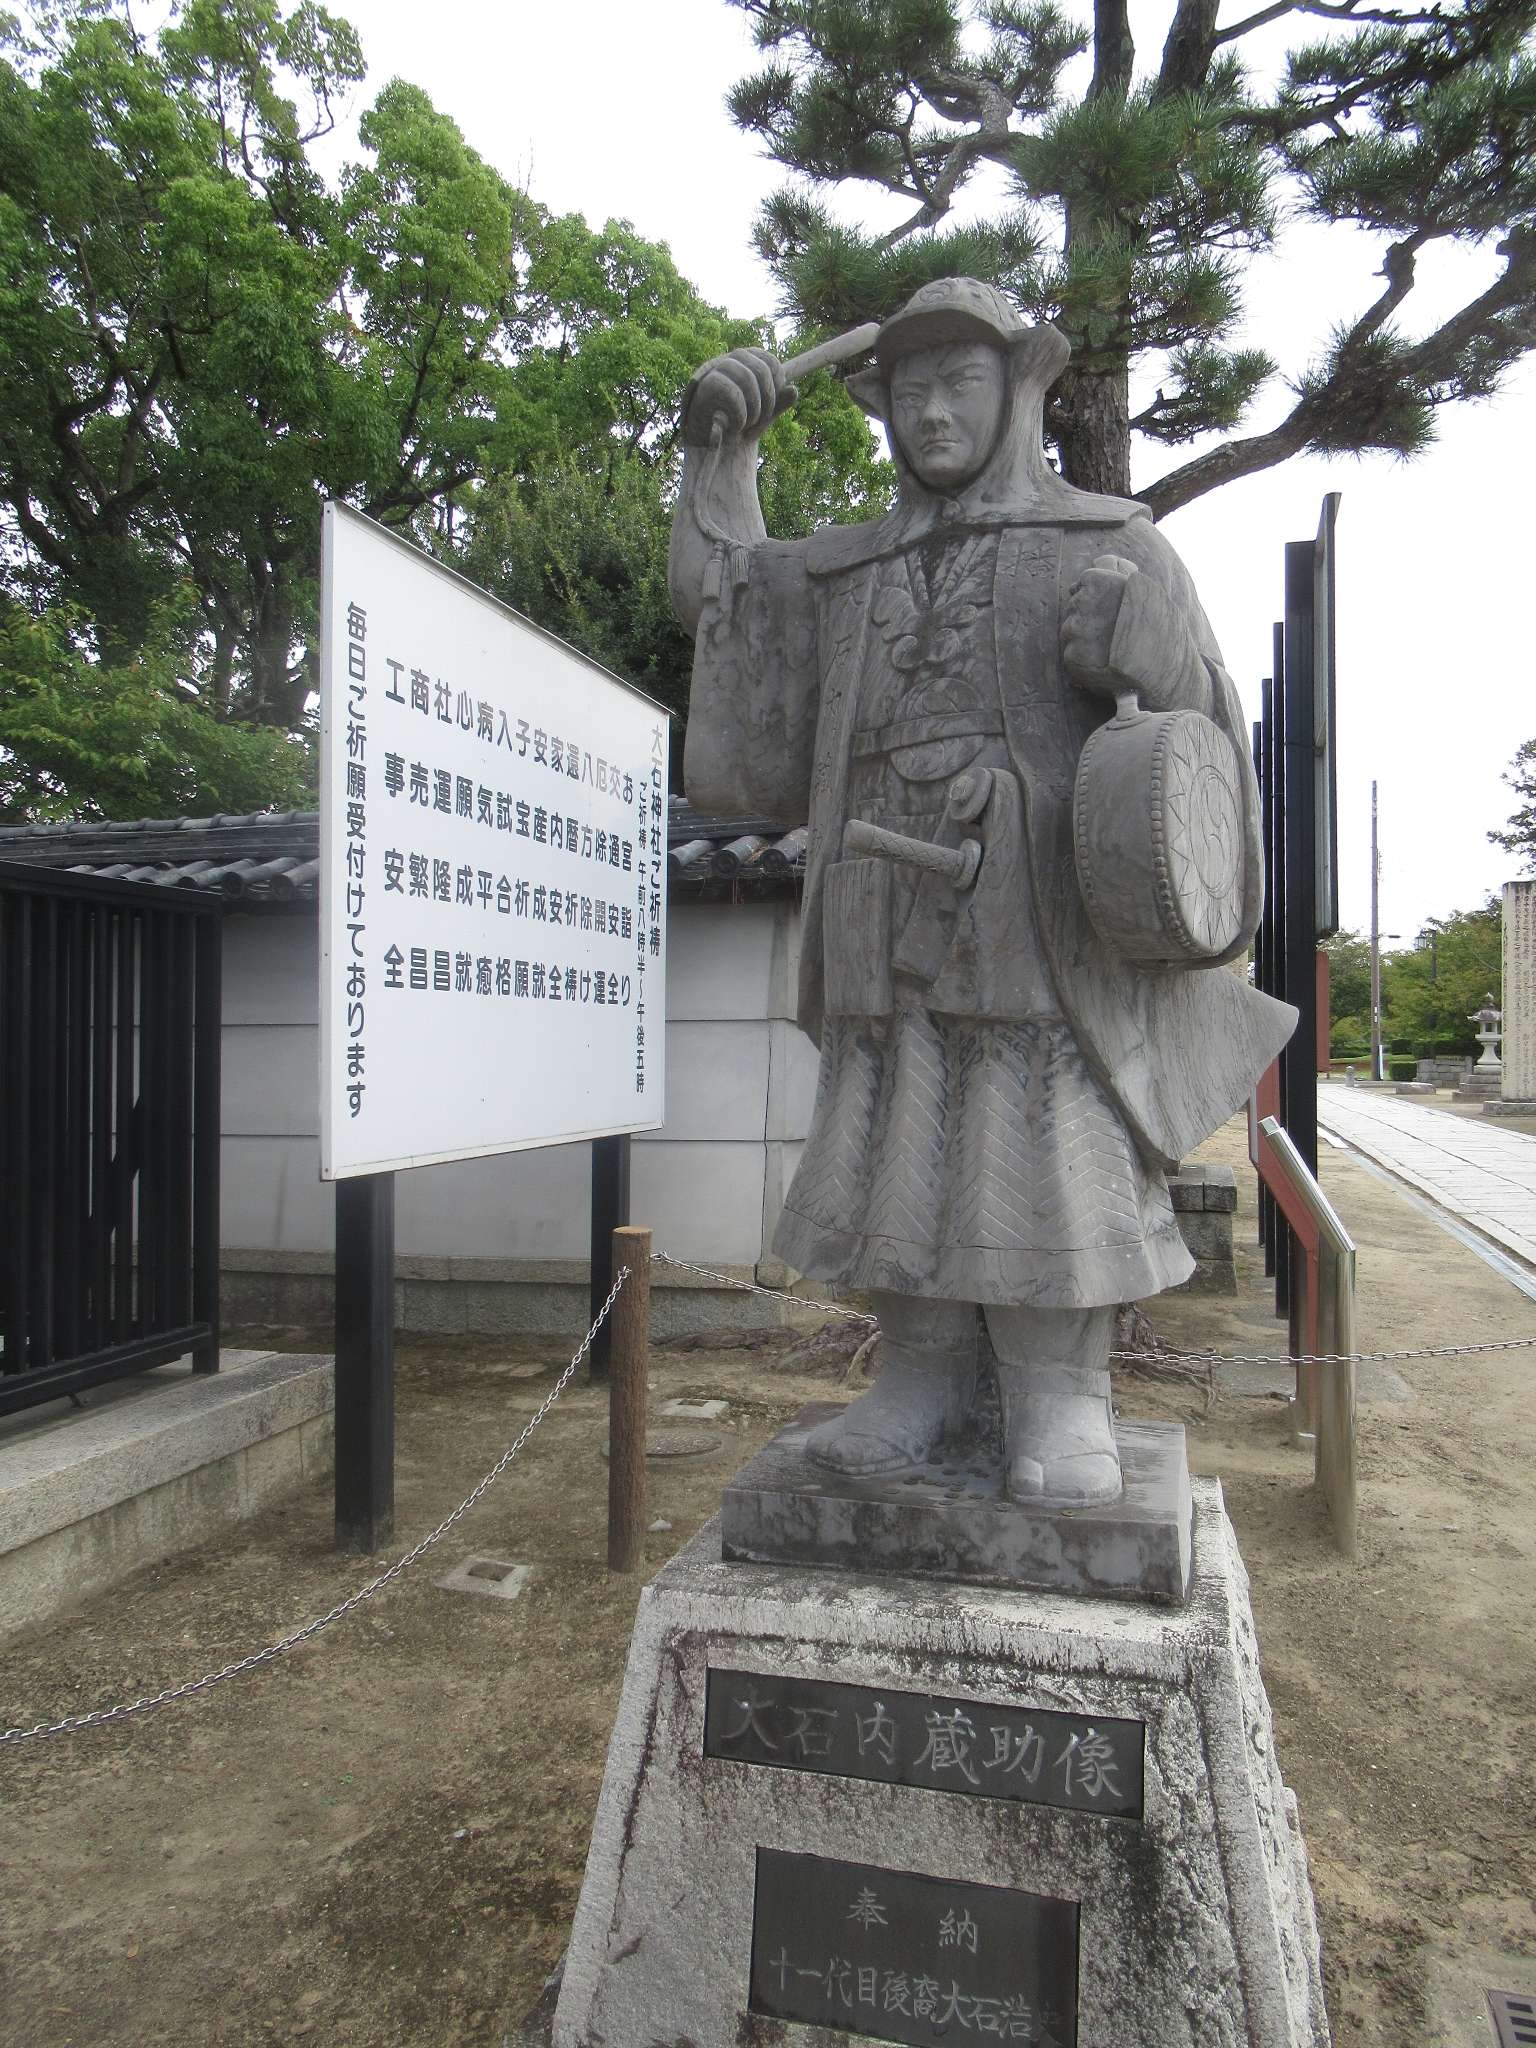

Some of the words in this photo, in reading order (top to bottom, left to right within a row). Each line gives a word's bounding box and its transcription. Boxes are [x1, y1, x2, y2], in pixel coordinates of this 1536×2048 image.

[346, 601, 368, 1118] 毎日ご祈願受付けております
[384, 657, 405, 988] 工事安全
[409, 668, 430, 990] 商売繁昌
[433, 678, 452, 991] 社運隆昌
[455, 690, 473, 992] 心願成就
[476, 701, 493, 995] 病気平癒
[496, 710, 512, 996] 入試合格
[515, 719, 530, 998] 子宝祈願
[532, 728, 547, 999] 安産成就
[549, 736, 563, 1000] 家内安全
[580, 752, 593, 1003] 八方除け
[594, 758, 607, 1004] 厄除開運
[608, 765, 620, 1005] 交通安全
[621, 772, 633, 1006] お宮詣り
[720, 1684, 1124, 1798] 大石内蔵助像
